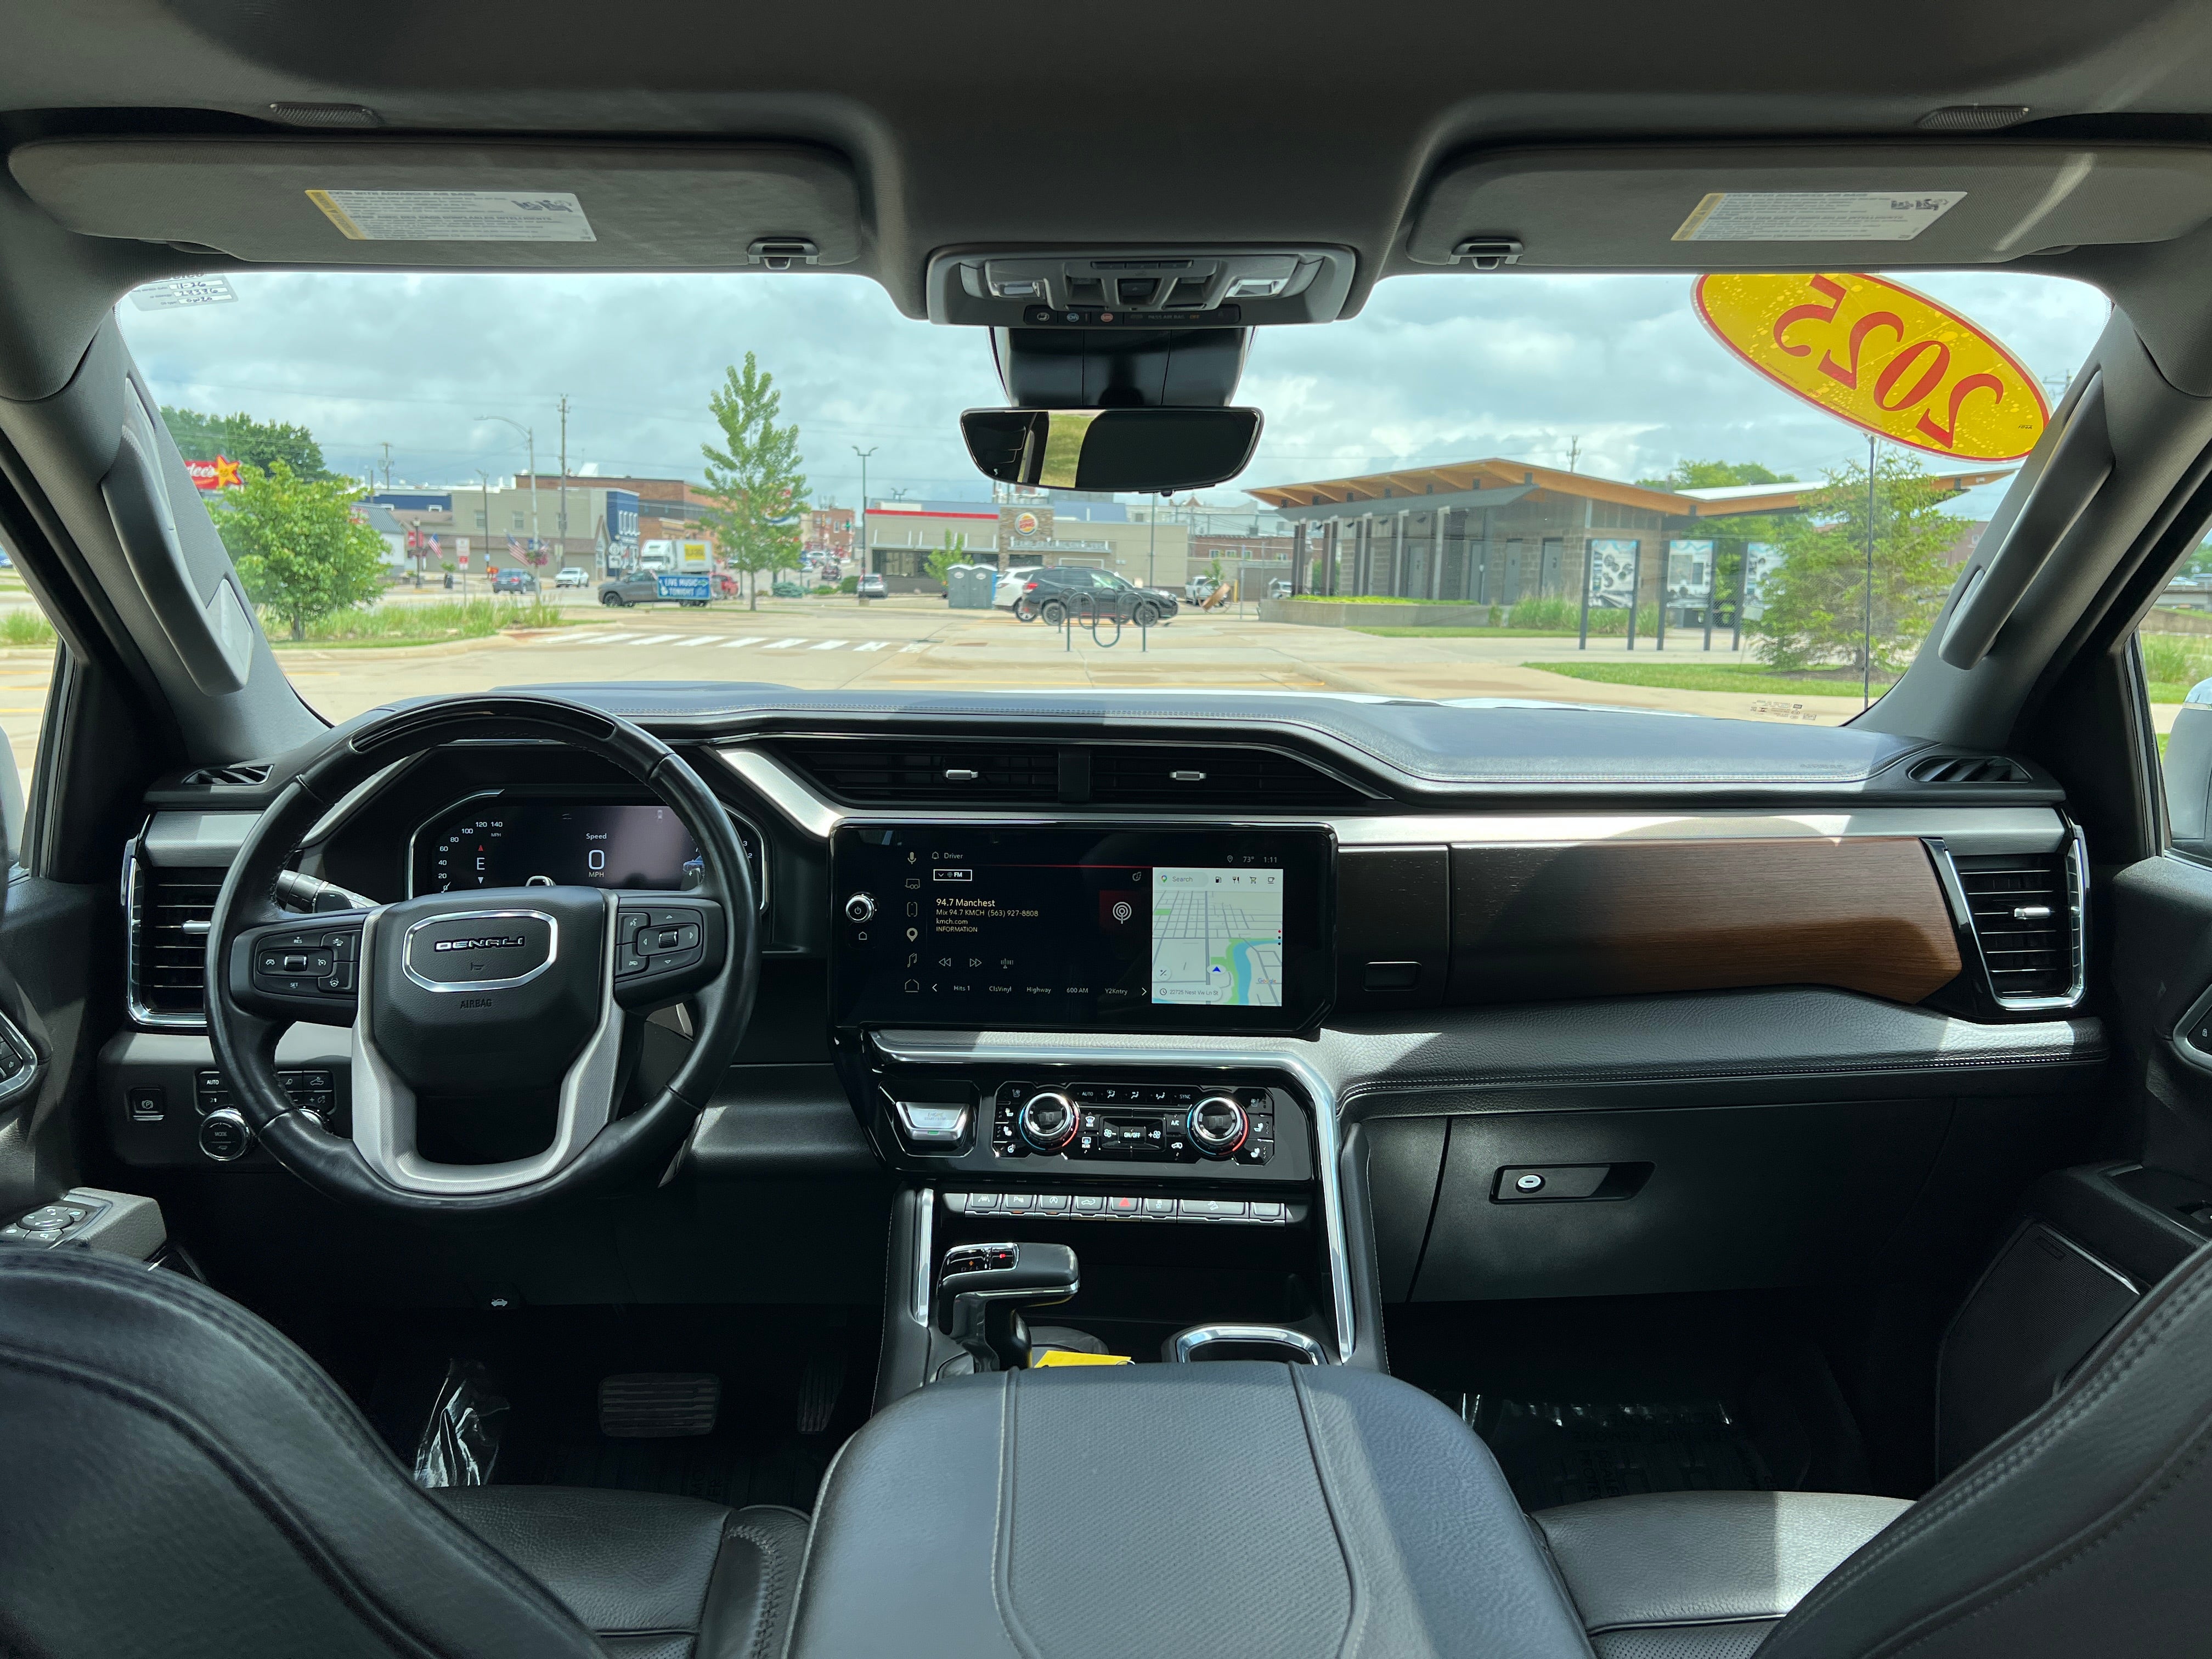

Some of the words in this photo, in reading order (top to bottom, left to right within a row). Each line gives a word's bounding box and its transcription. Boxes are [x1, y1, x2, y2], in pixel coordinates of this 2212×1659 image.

[664, 578, 678, 586] LIVE
[679, 578, 698, 587] MUSIC
[668, 587, 695, 596] TONIGHT
[476, 857, 486, 870] E
[588, 849, 605, 870] 0
[936, 898, 953, 906] 94.7
[956, 899, 996, 907] Manchest
[988, 910, 1006, 918] (563)
[436, 936, 524, 951] DENALI
[1104, 988, 1128, 996] Y2Kntry
[460, 998, 493, 1009] AIRBAG
